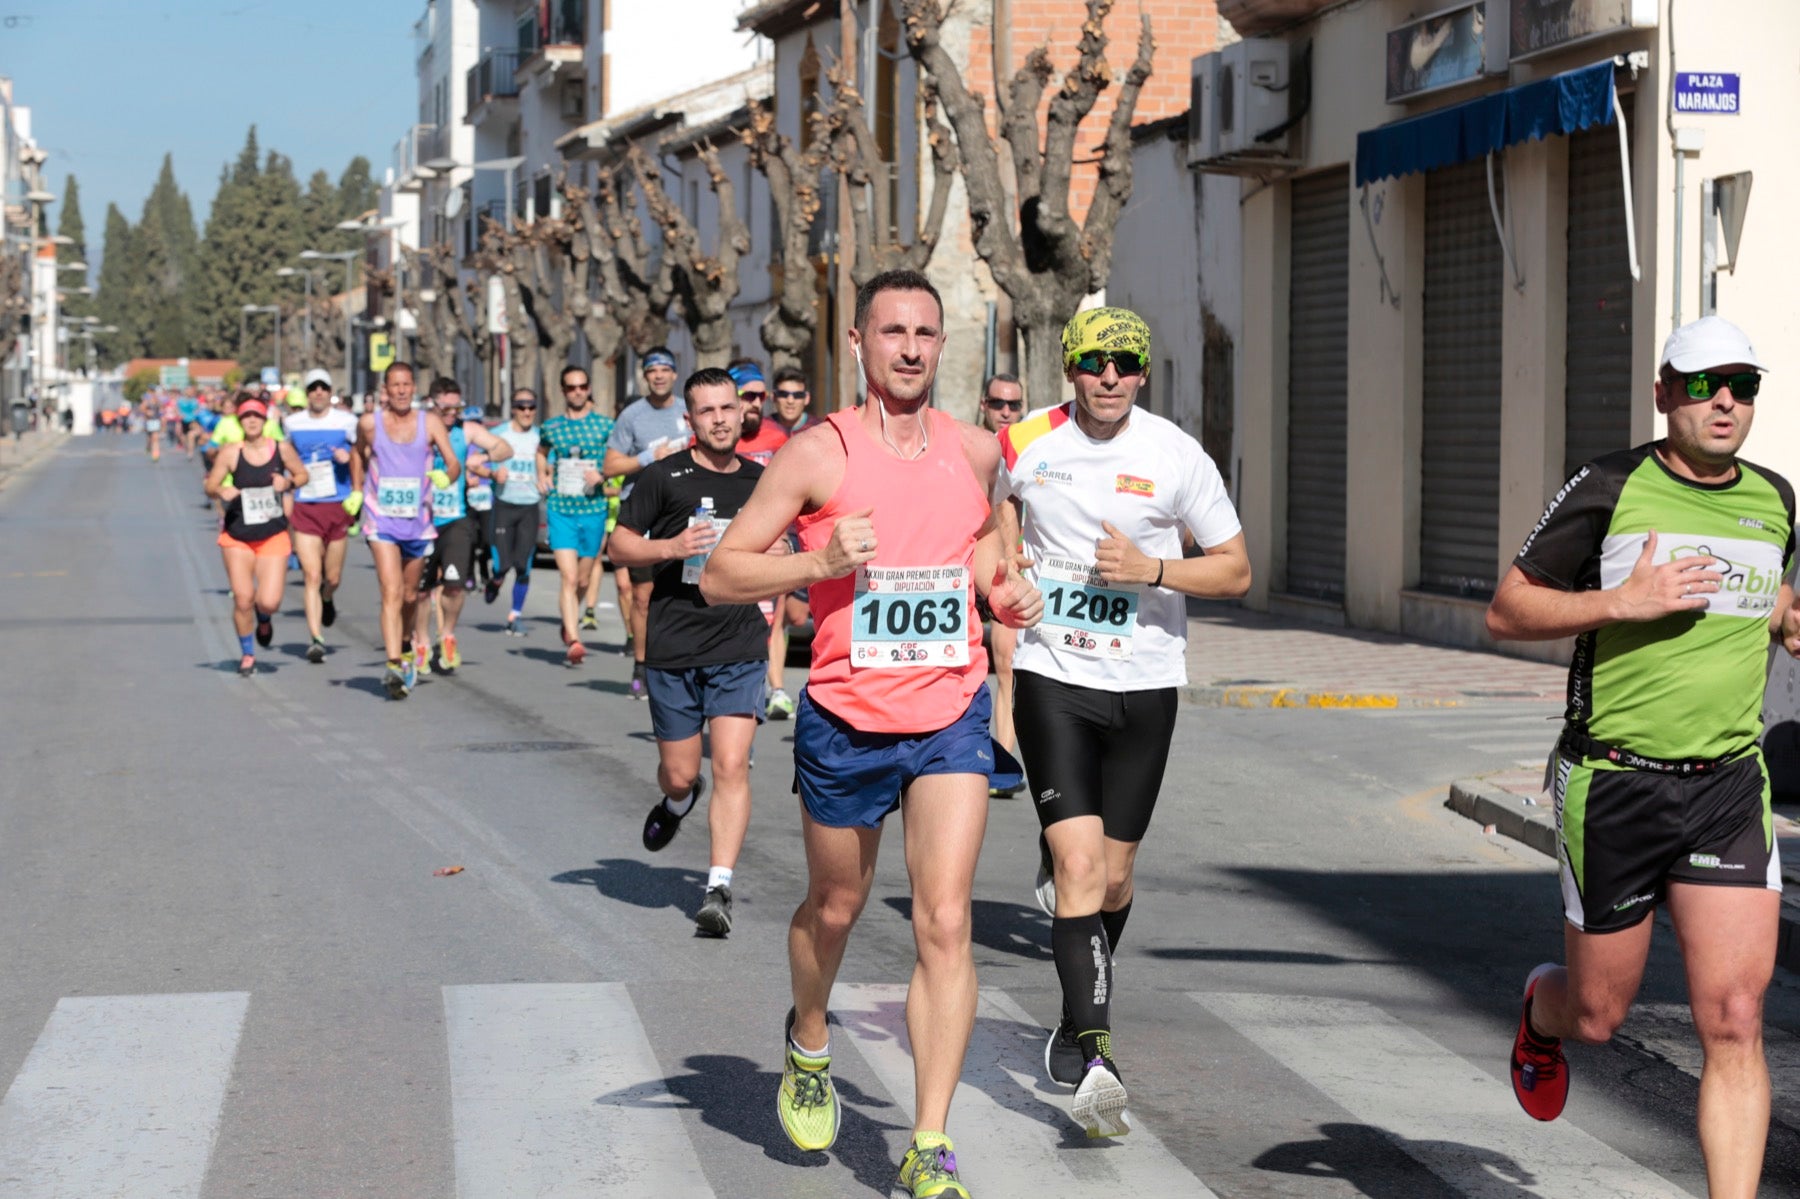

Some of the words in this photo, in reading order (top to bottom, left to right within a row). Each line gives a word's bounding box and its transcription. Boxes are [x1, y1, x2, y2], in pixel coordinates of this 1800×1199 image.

[1688, 74, 1724, 88] PLAZA
[1678, 92, 1737, 111] NARANJOS
[385, 490, 415, 504] 539
[1519, 466, 1591, 558] GRANABIKE
[886, 570, 905, 580] GRAN
[906, 570, 931, 580] PREMIO
[933, 569, 941, 579] DE
[942, 568, 963, 578] FONDO
[1065, 561, 1083, 572] GRAN
[1048, 587, 1130, 626] 1208
[861, 598, 962, 635] 1063
